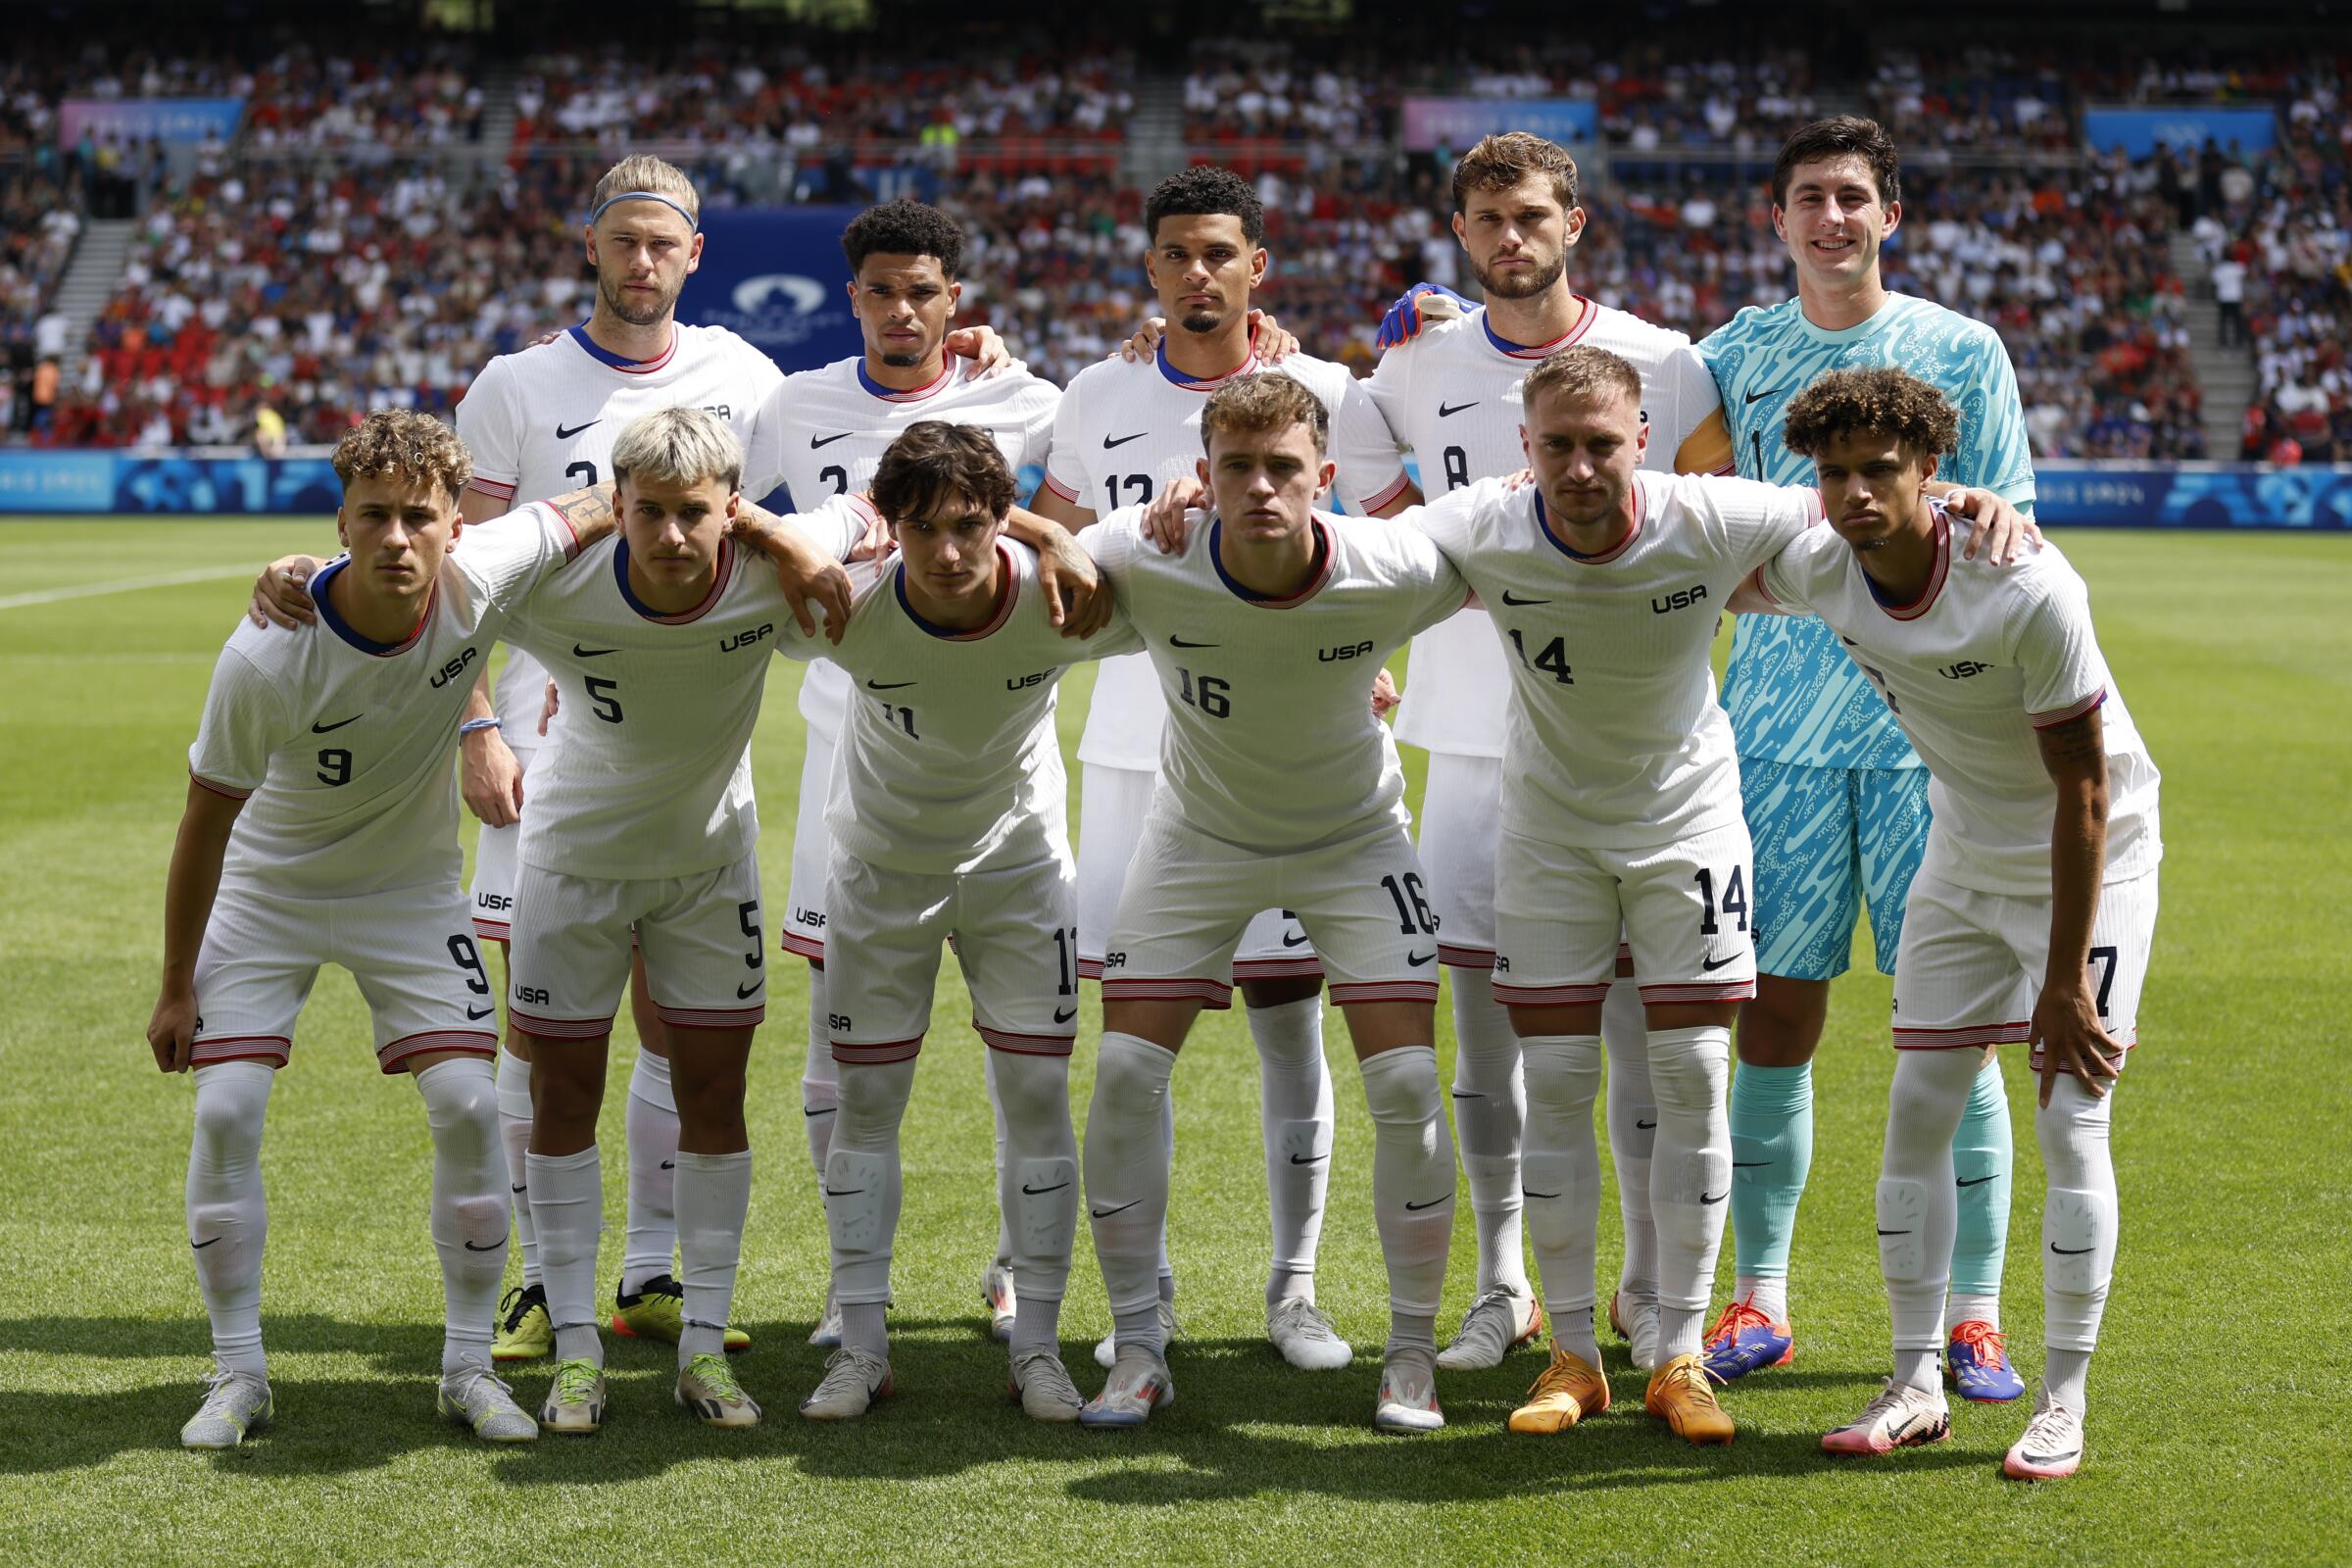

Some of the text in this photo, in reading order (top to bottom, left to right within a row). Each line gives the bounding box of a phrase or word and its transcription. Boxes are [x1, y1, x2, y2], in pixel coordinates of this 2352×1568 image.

[698, 404, 731, 420] SA
[1444, 446, 1469, 492] 8
[1752, 430, 1763, 482] 1
[1651, 584, 1707, 613] USA
[720, 623, 773, 653] USA
[1318, 641, 1374, 662] USA
[1507, 628, 1574, 685] 14
[430, 647, 477, 689] USA
[584, 675, 623, 723] 5
[1175, 666, 1231, 718] 16
[317, 749, 352, 787] 9
[1381, 872, 1434, 934] 16
[1694, 864, 1746, 935] 14
[738, 900, 762, 969] 5
[447, 934, 489, 994] 9
[1104, 953, 1126, 968] SA
[2087, 946, 2117, 1017] 7
[514, 984, 549, 1005] USA
